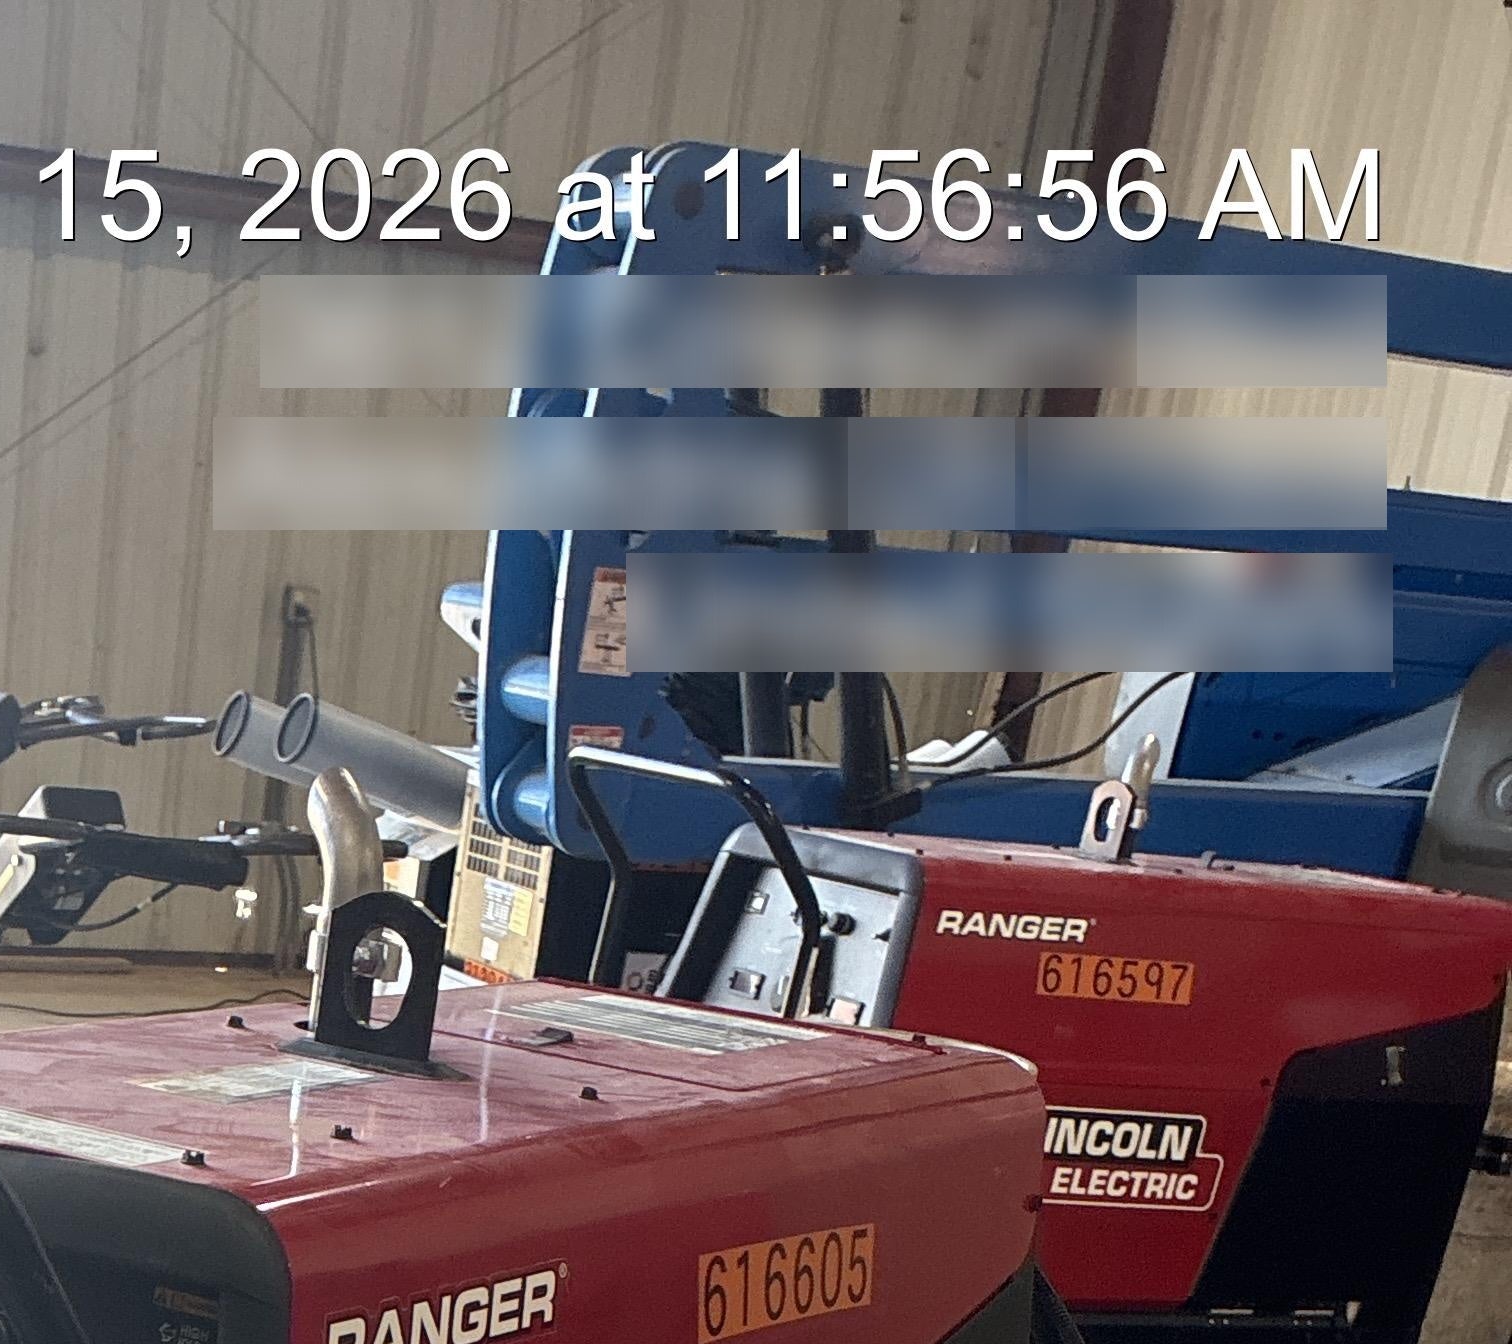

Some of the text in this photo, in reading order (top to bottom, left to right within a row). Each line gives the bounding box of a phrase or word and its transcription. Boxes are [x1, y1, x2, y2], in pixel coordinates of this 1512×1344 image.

[936, 910, 1088, 943] RANGER
[1042, 954, 1189, 1000] 616597
[1044, 1117, 1192, 1161] INCOLN
[1050, 1166, 1198, 1200] ELECTRIC
[703, 1228, 870, 1337] 616605
